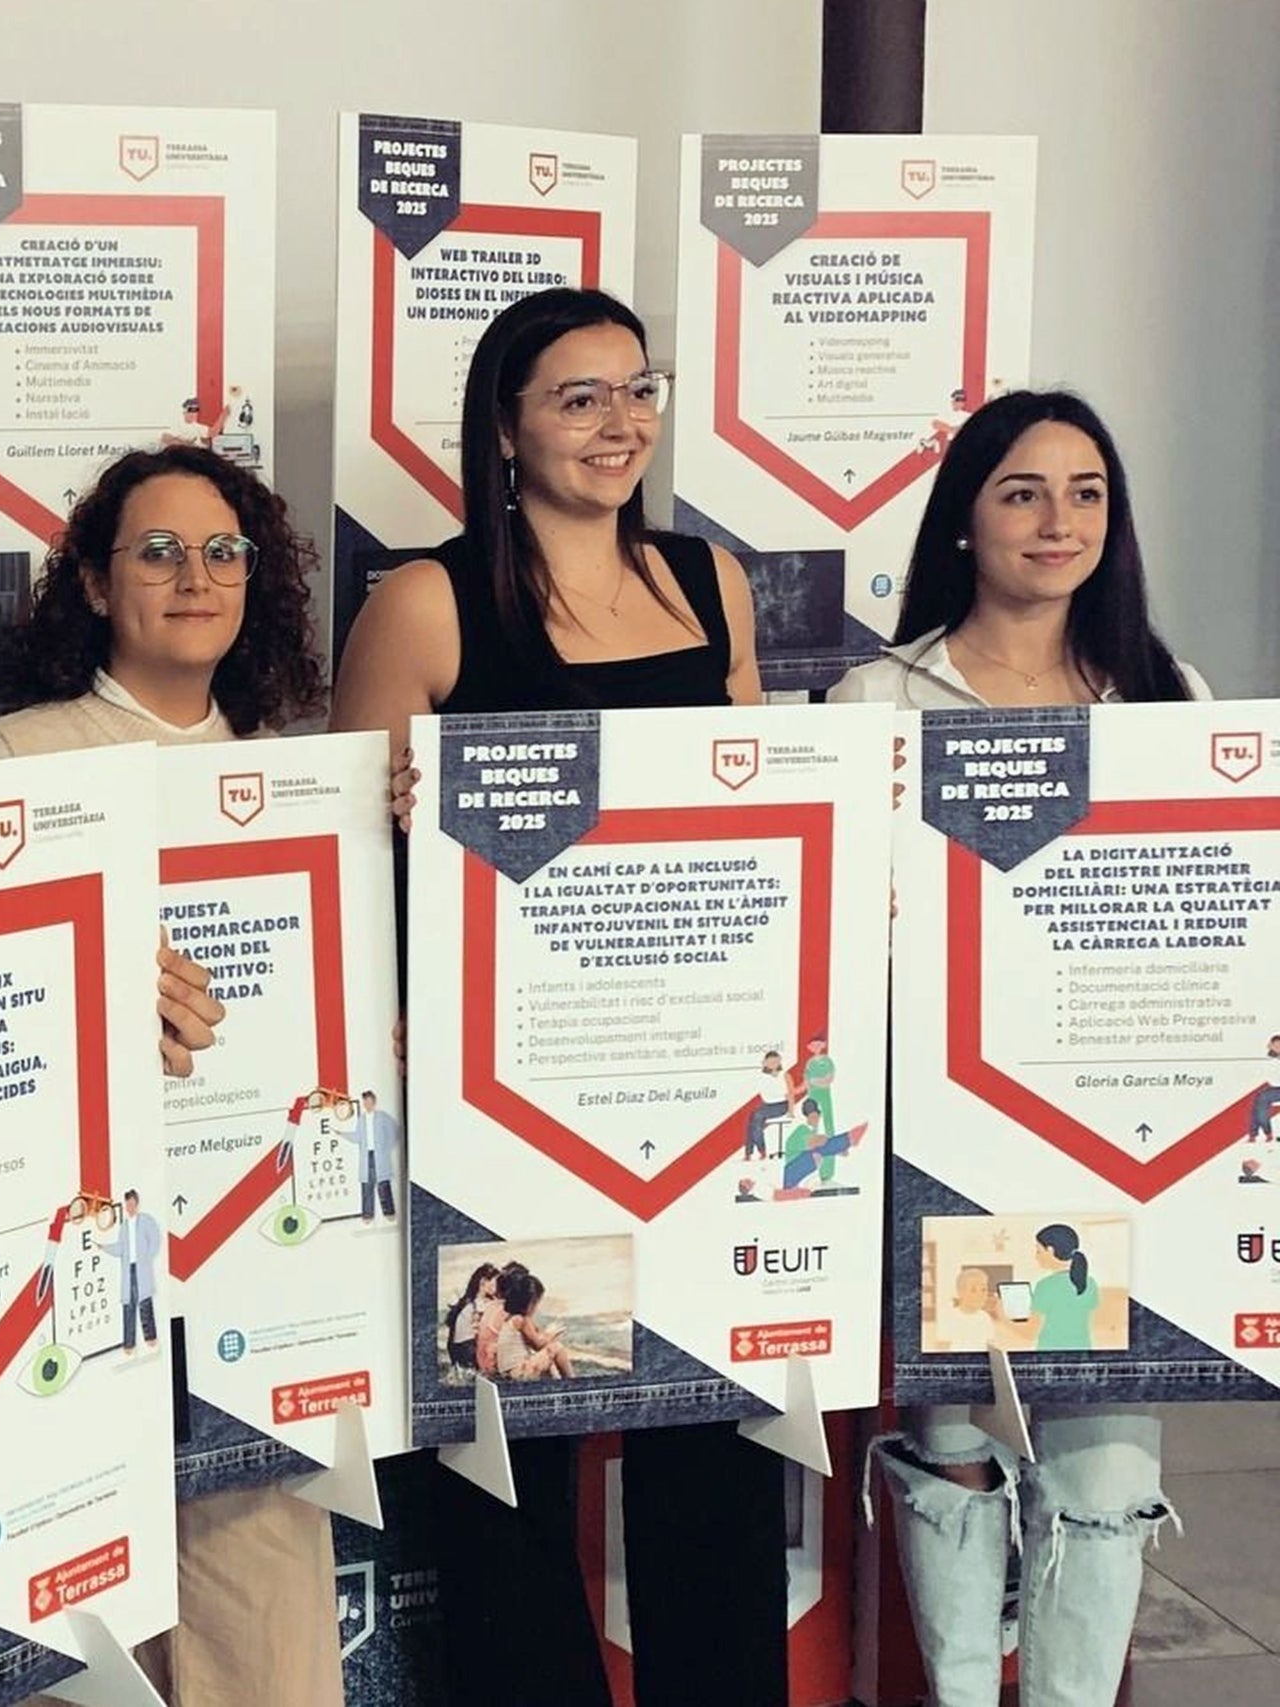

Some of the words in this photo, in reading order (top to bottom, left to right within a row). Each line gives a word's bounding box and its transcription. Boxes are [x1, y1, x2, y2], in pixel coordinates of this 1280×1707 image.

[373, 140, 446, 158] PROJECTES
[385, 160, 435, 177] BEQUES
[718, 158, 802, 171] PROJECTES
[370, 179, 387, 193] DE
[390, 180, 449, 197] RECERCA
[730, 176, 788, 191] BEQUES
[396, 200, 426, 215] 2025
[714, 194, 733, 207] DE
[737, 194, 804, 207] RECERCA
[744, 212, 778, 225] 2025
[20, 238, 80, 250] CREACIÓ
[84, 240, 118, 251] D'UN
[91, 256, 162, 267] IMMERSIU:
[440, 248, 467, 261] WEB
[471, 249, 522, 264] TRAILER
[809, 251, 877, 266] CREACIÓ
[881, 253, 900, 266] DE
[411, 266, 499, 282] INTERACTIVO
[502, 270, 524, 283] DEL
[527, 271, 566, 285] LIBRO:
[772, 292, 851, 304] REACTIVA
[856, 291, 934, 304] APLICADA
[783, 311, 803, 323] AL
[808, 309, 926, 323] VIDEOMAPPING
[60, 321, 163, 332] AUDIOVISUALS
[463, 743, 577, 761] PROJECTES
[945, 736, 1065, 755] PROJECTES
[480, 766, 559, 786] BEQUES
[964, 759, 1046, 778] BEQUES
[458, 792, 485, 808] DE
[489, 789, 581, 807] RECERCA
[941, 784, 969, 800] DE
[973, 781, 1069, 799] RECERCA
[983, 804, 1033, 821] 2025
[498, 813, 545, 830] 2025
[1062, 849, 1084, 861] LA
[1090, 842, 1232, 860] DIGITALITZACIÓ
[548, 866, 567, 878] EN
[572, 862, 610, 877] CAMÍ
[614, 863, 645, 876] CAP
[649, 863, 660, 874] A
[664, 862, 683, 874] LA
[688, 856, 757, 873] INCLUSIÓ
[1044, 867, 1074, 879] DEL
[1080, 865, 1160, 878] REGISTRE
[1166, 862, 1250, 876] INFERMER
[519, 904, 586, 917] TERAPIA
[590, 899, 701, 914] OCUPACIONAL
[705, 898, 724, 910] EN
[728, 894, 788, 909] L'ÀMBIT
[171, 915, 299, 941] BIOMARCADOR
[1047, 918, 1168, 933] ASSISTENCIAL
[1173, 918, 1178, 929] I
[1184, 916, 1247, 930] REDUIR
[240, 940, 270, 955] DEL
[1052, 938, 1074, 950] LA
[1079, 935, 1159, 950] CÀRREGA
[1165, 935, 1246, 948] LABORAL
[579, 950, 669, 968] D'EXCLUSIÓ
[673, 950, 727, 964] SOCIAL
[528, 981, 575, 993] Infants
[585, 977, 665, 991] adolescents
[82, 1230, 91, 1251] E
[763, 1245, 828, 1273] EUIT
[758, 1339, 827, 1355] Terrassa
[57, 1563, 125, 1604] Terrassa
